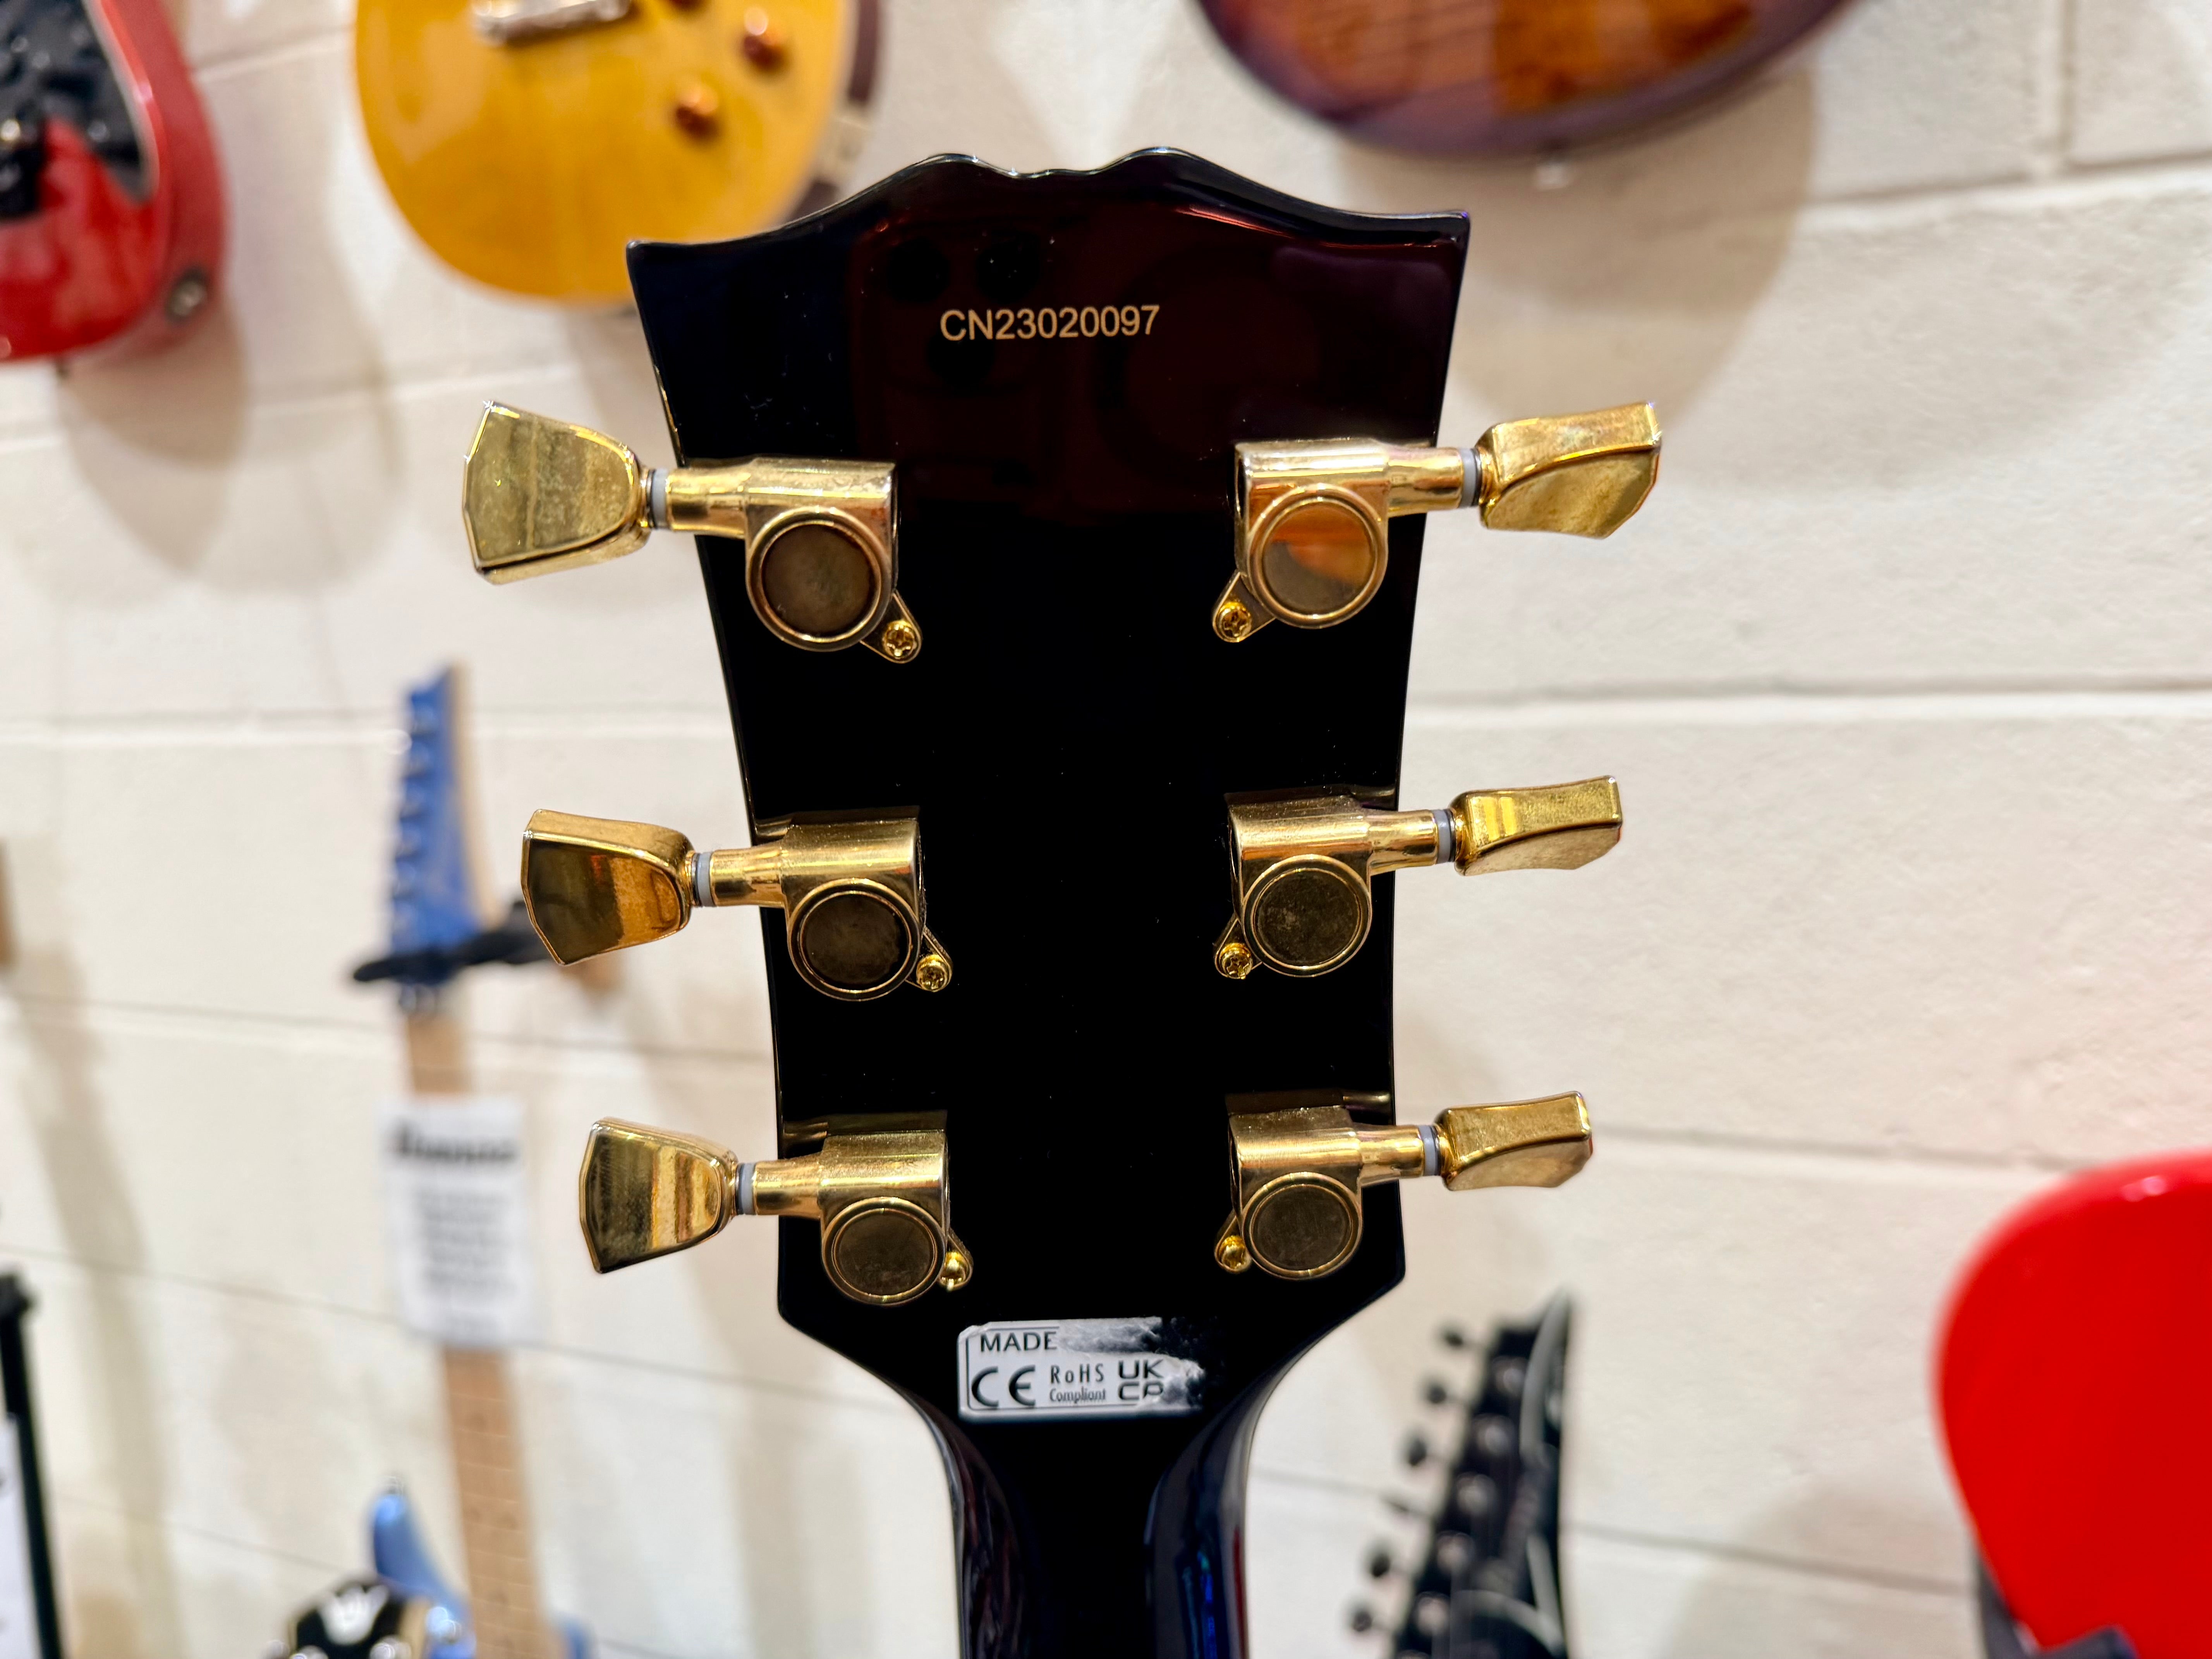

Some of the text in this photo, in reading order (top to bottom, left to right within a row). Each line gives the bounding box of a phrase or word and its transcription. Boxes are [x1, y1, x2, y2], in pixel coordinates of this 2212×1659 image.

[940, 305, 1160, 341] CN23020097
[980, 1331, 1058, 1352] MADE
[1050, 1363, 1104, 1384] RoHS
[1118, 1359, 1163, 1379] UK
[971, 1364, 1036, 1407] CE
[1049, 1387, 1106, 1403] Compliant
